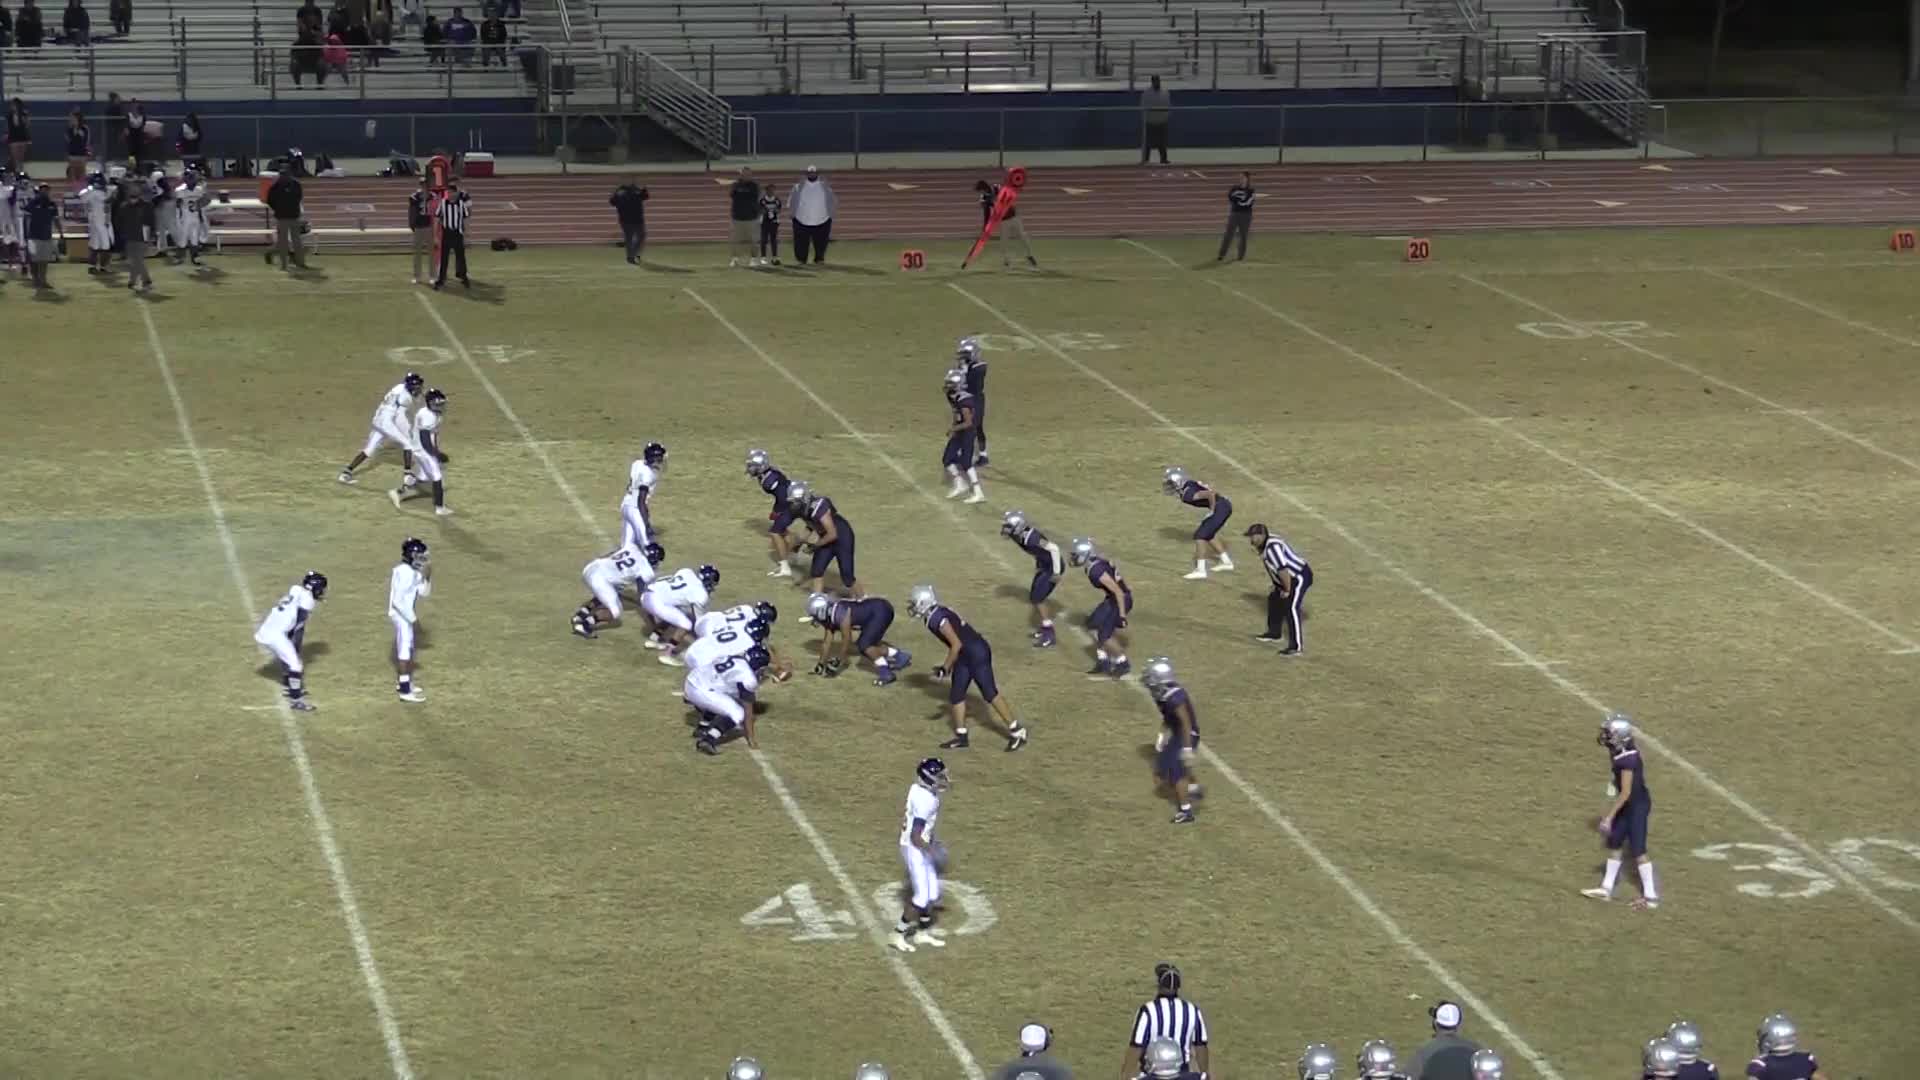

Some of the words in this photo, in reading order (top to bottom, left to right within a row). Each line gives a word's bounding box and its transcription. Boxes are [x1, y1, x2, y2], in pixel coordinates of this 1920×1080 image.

[431, 166, 443, 187] 1
[1410, 241, 1429, 259] 20
[903, 253, 923, 269] 30
